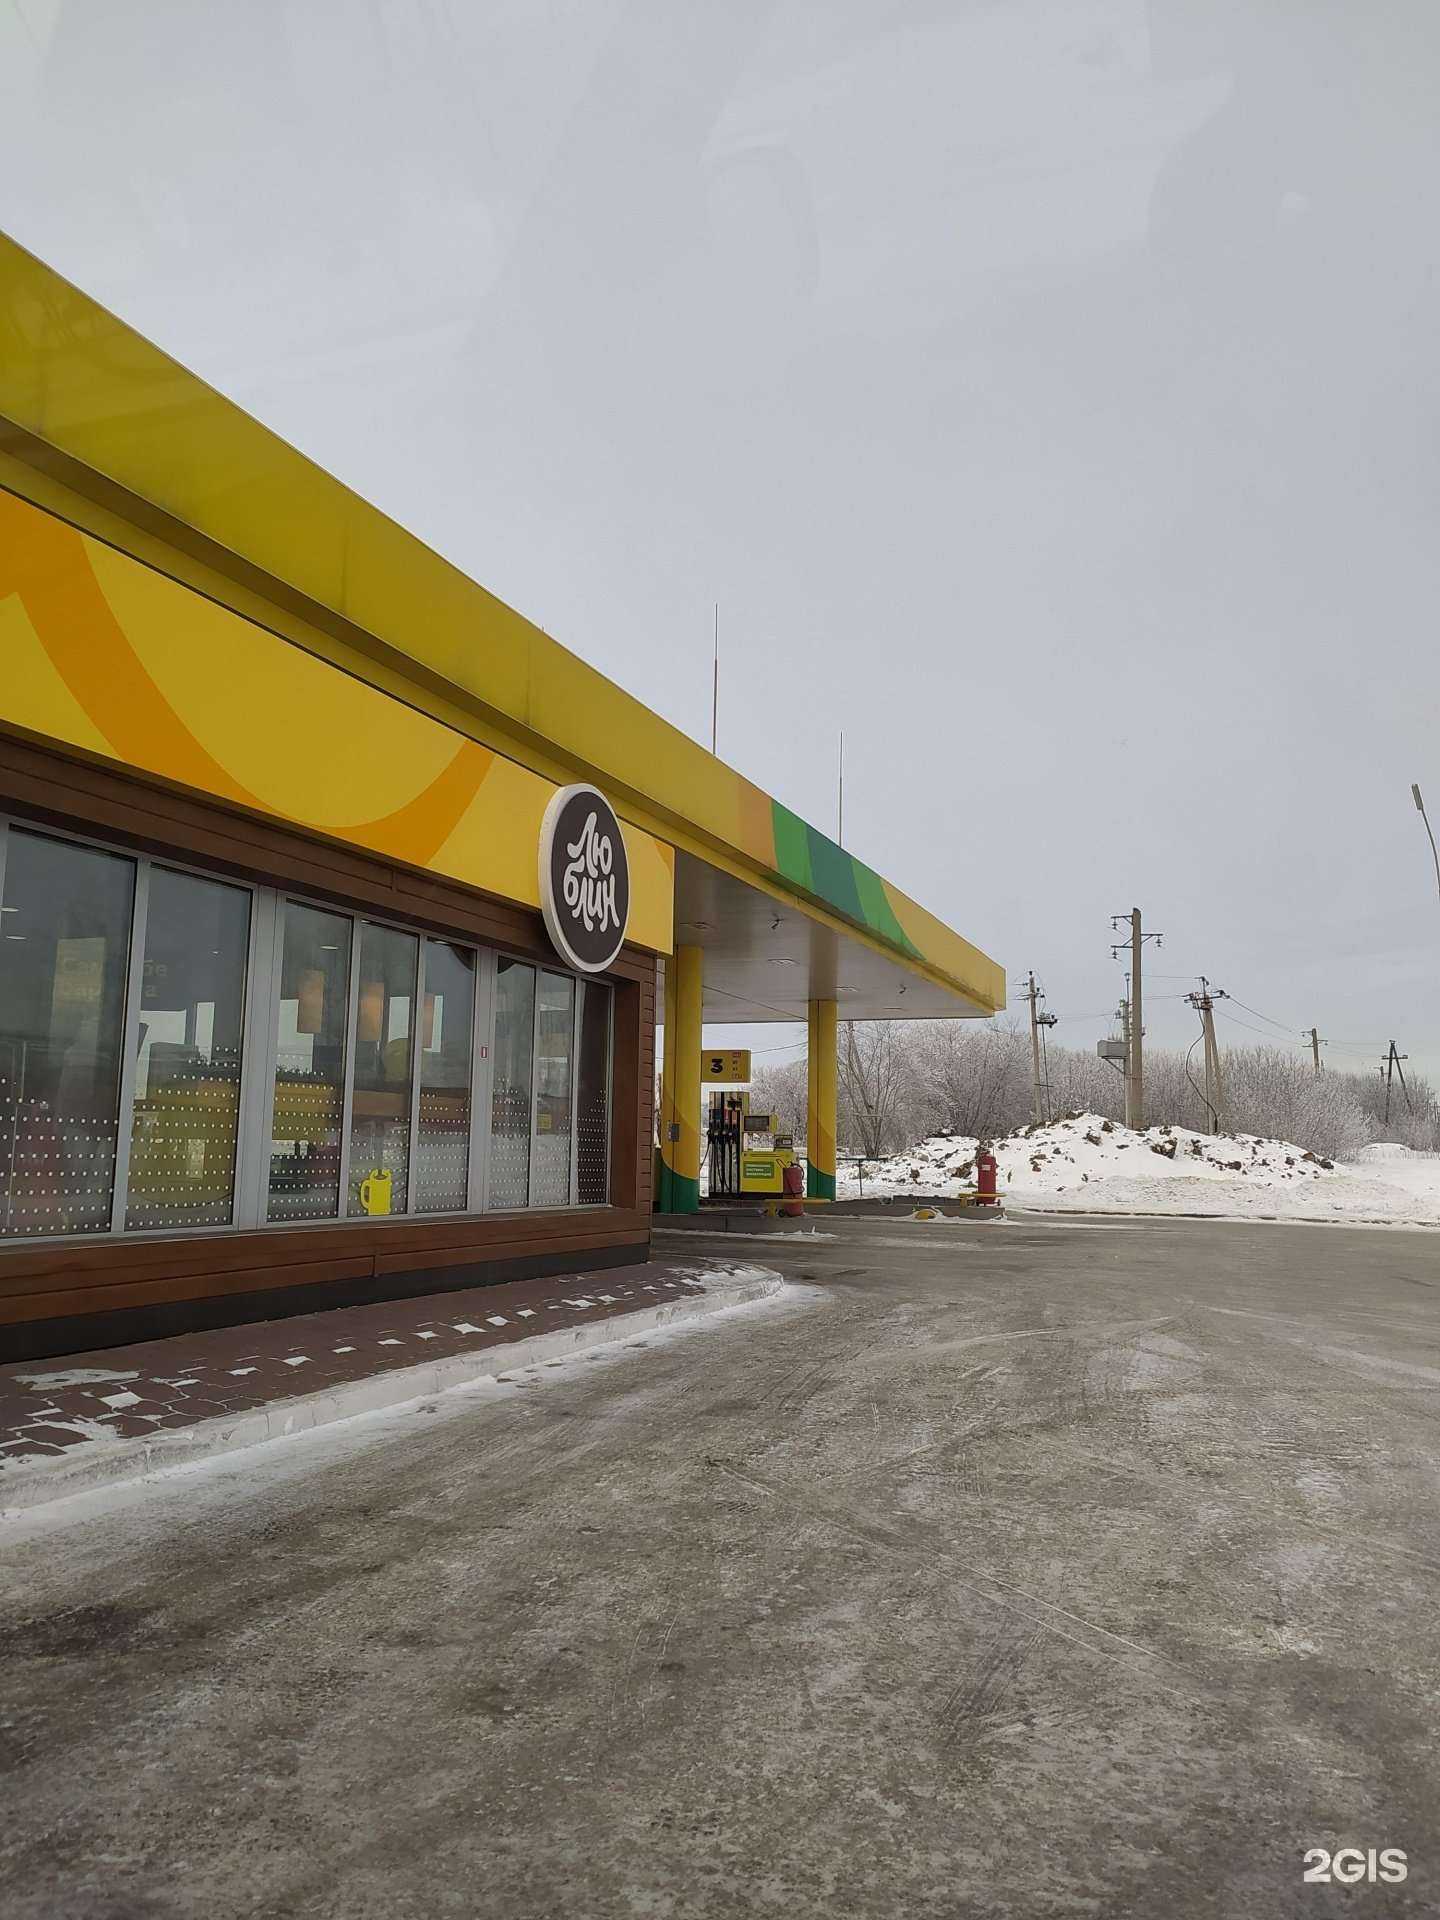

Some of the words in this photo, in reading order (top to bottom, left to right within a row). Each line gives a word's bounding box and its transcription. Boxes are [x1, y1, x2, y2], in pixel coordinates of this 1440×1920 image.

[567, 812, 612, 878] Лю
[563, 855, 620, 932] блин
[711, 1058, 723, 1073] 3
